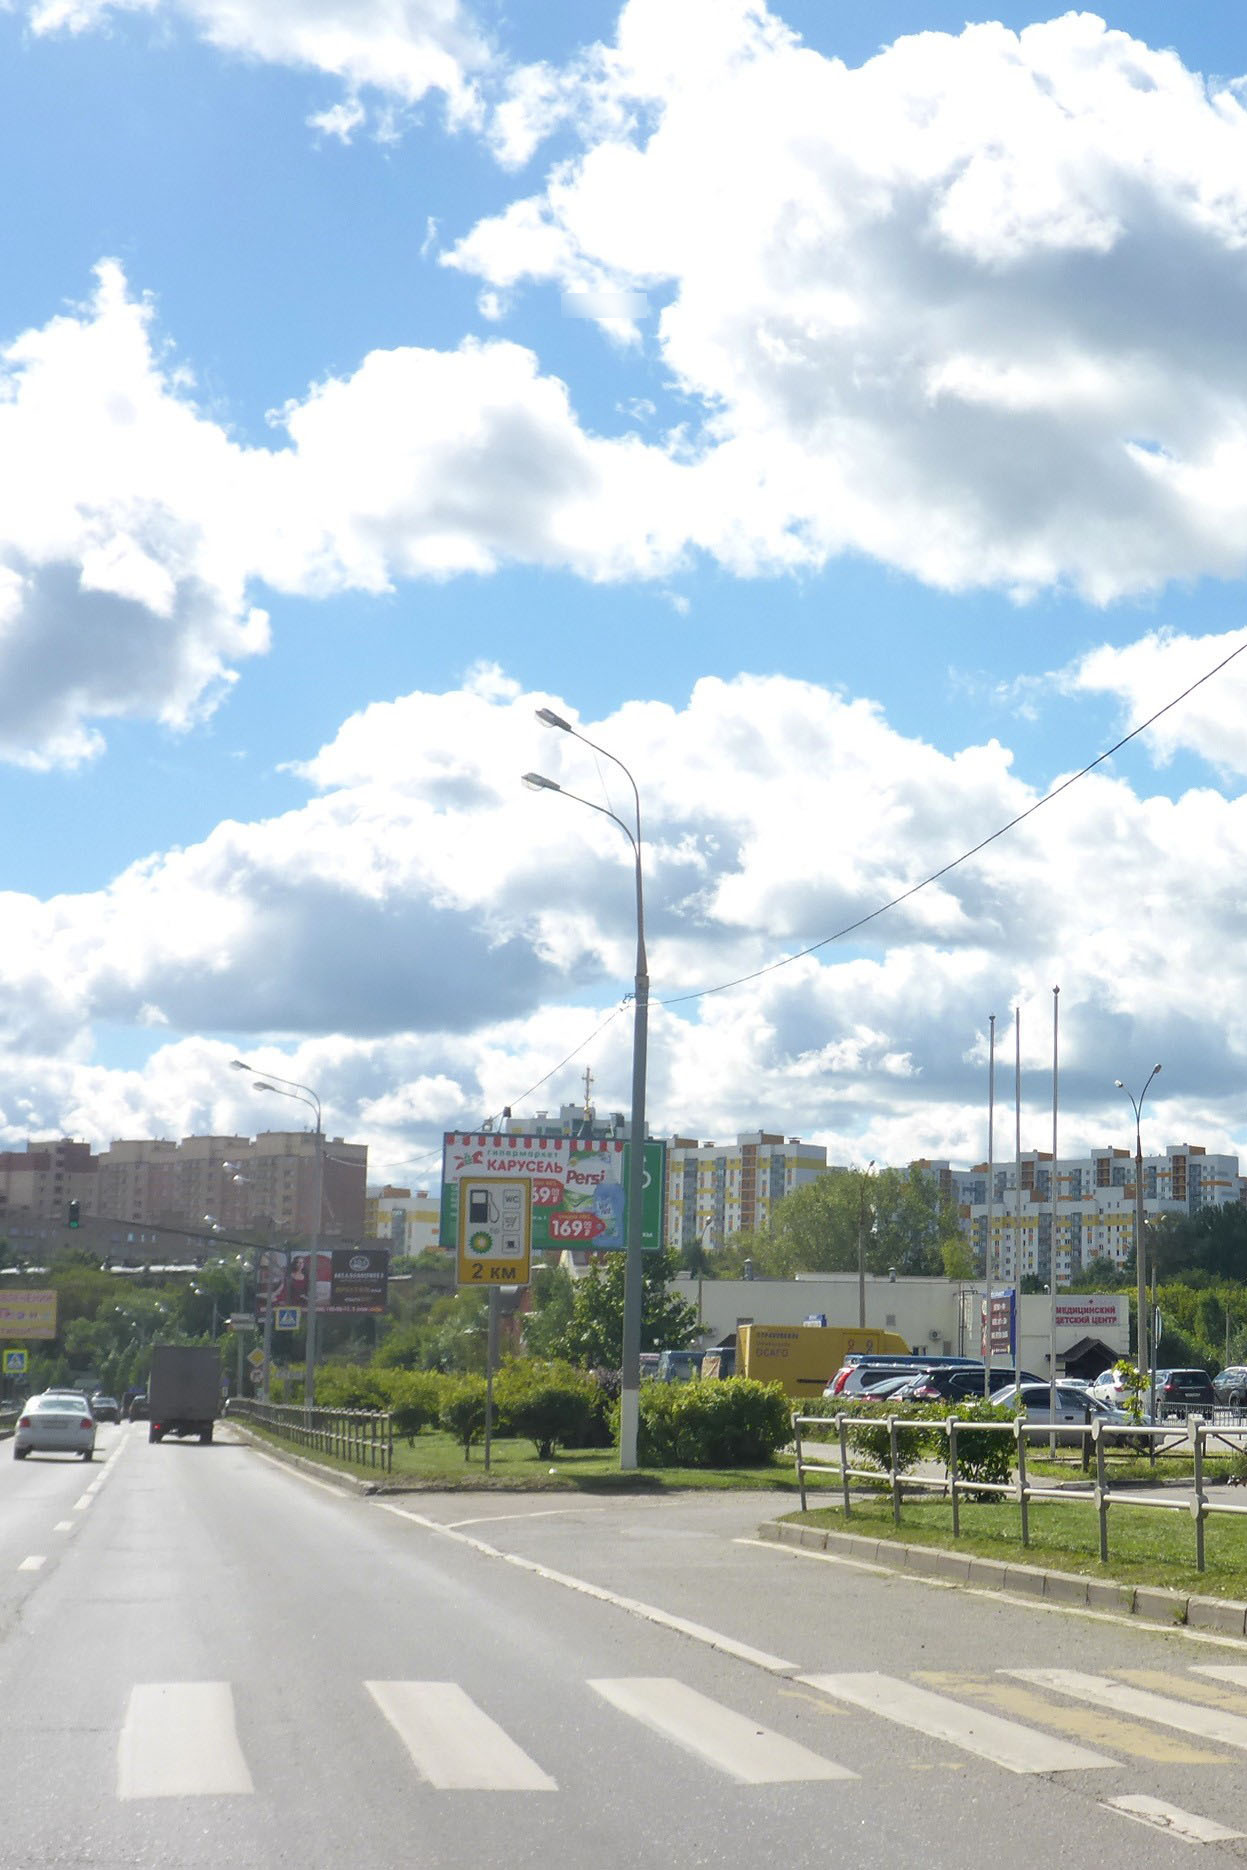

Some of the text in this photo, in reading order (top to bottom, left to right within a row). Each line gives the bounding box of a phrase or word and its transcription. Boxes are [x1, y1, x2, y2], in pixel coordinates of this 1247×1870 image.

[487, 1159, 563, 1174] КАРУСЕЛЬ
[552, 1220, 583, 1237] 169
[472, 1263, 484, 1280] 2
[1055, 1305, 1116, 1315] МЕДИЦИНСКИЙ
[1055, 1316, 1117, 1324] ДЕТСКИЙ ЦЕНТР
